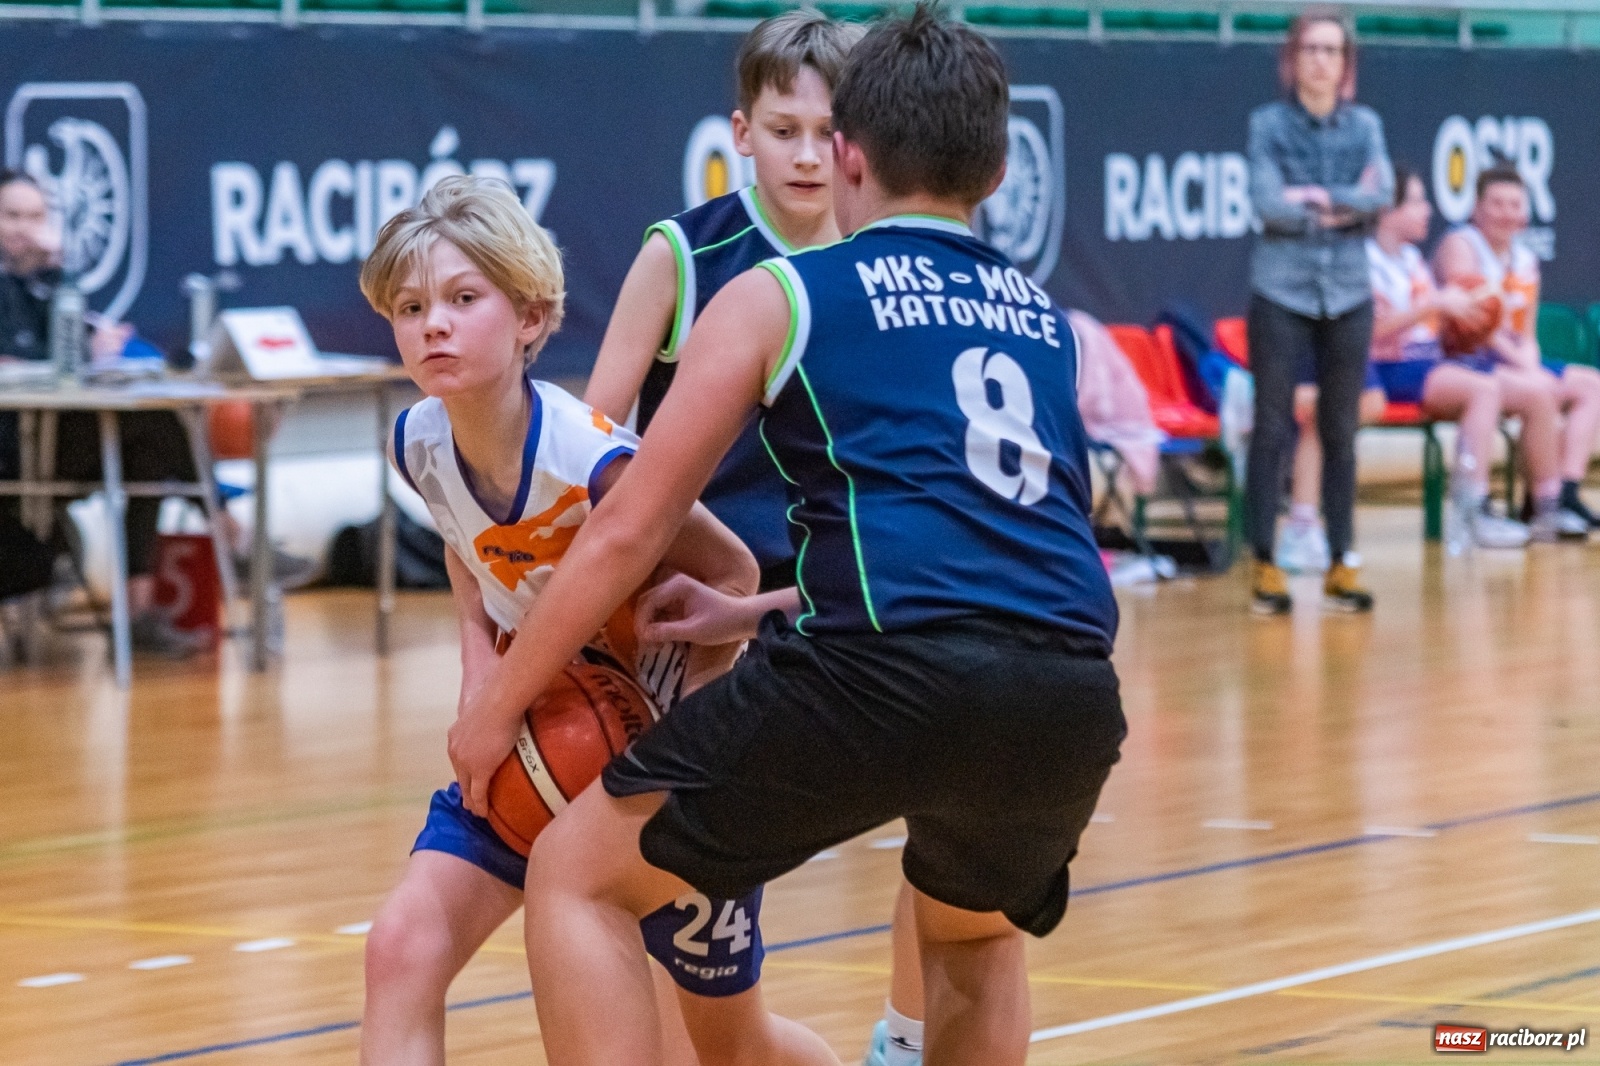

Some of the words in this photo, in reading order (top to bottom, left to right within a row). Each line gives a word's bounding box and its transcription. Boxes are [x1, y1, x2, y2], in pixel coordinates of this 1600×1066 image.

[855, 255, 944, 297] MKS
[975, 264, 1051, 310] MOS
[870, 295, 1061, 348] KATOWICE
[951, 347, 1052, 506] 8
[673, 892, 751, 957] 24
[674, 957, 739, 980] regio
